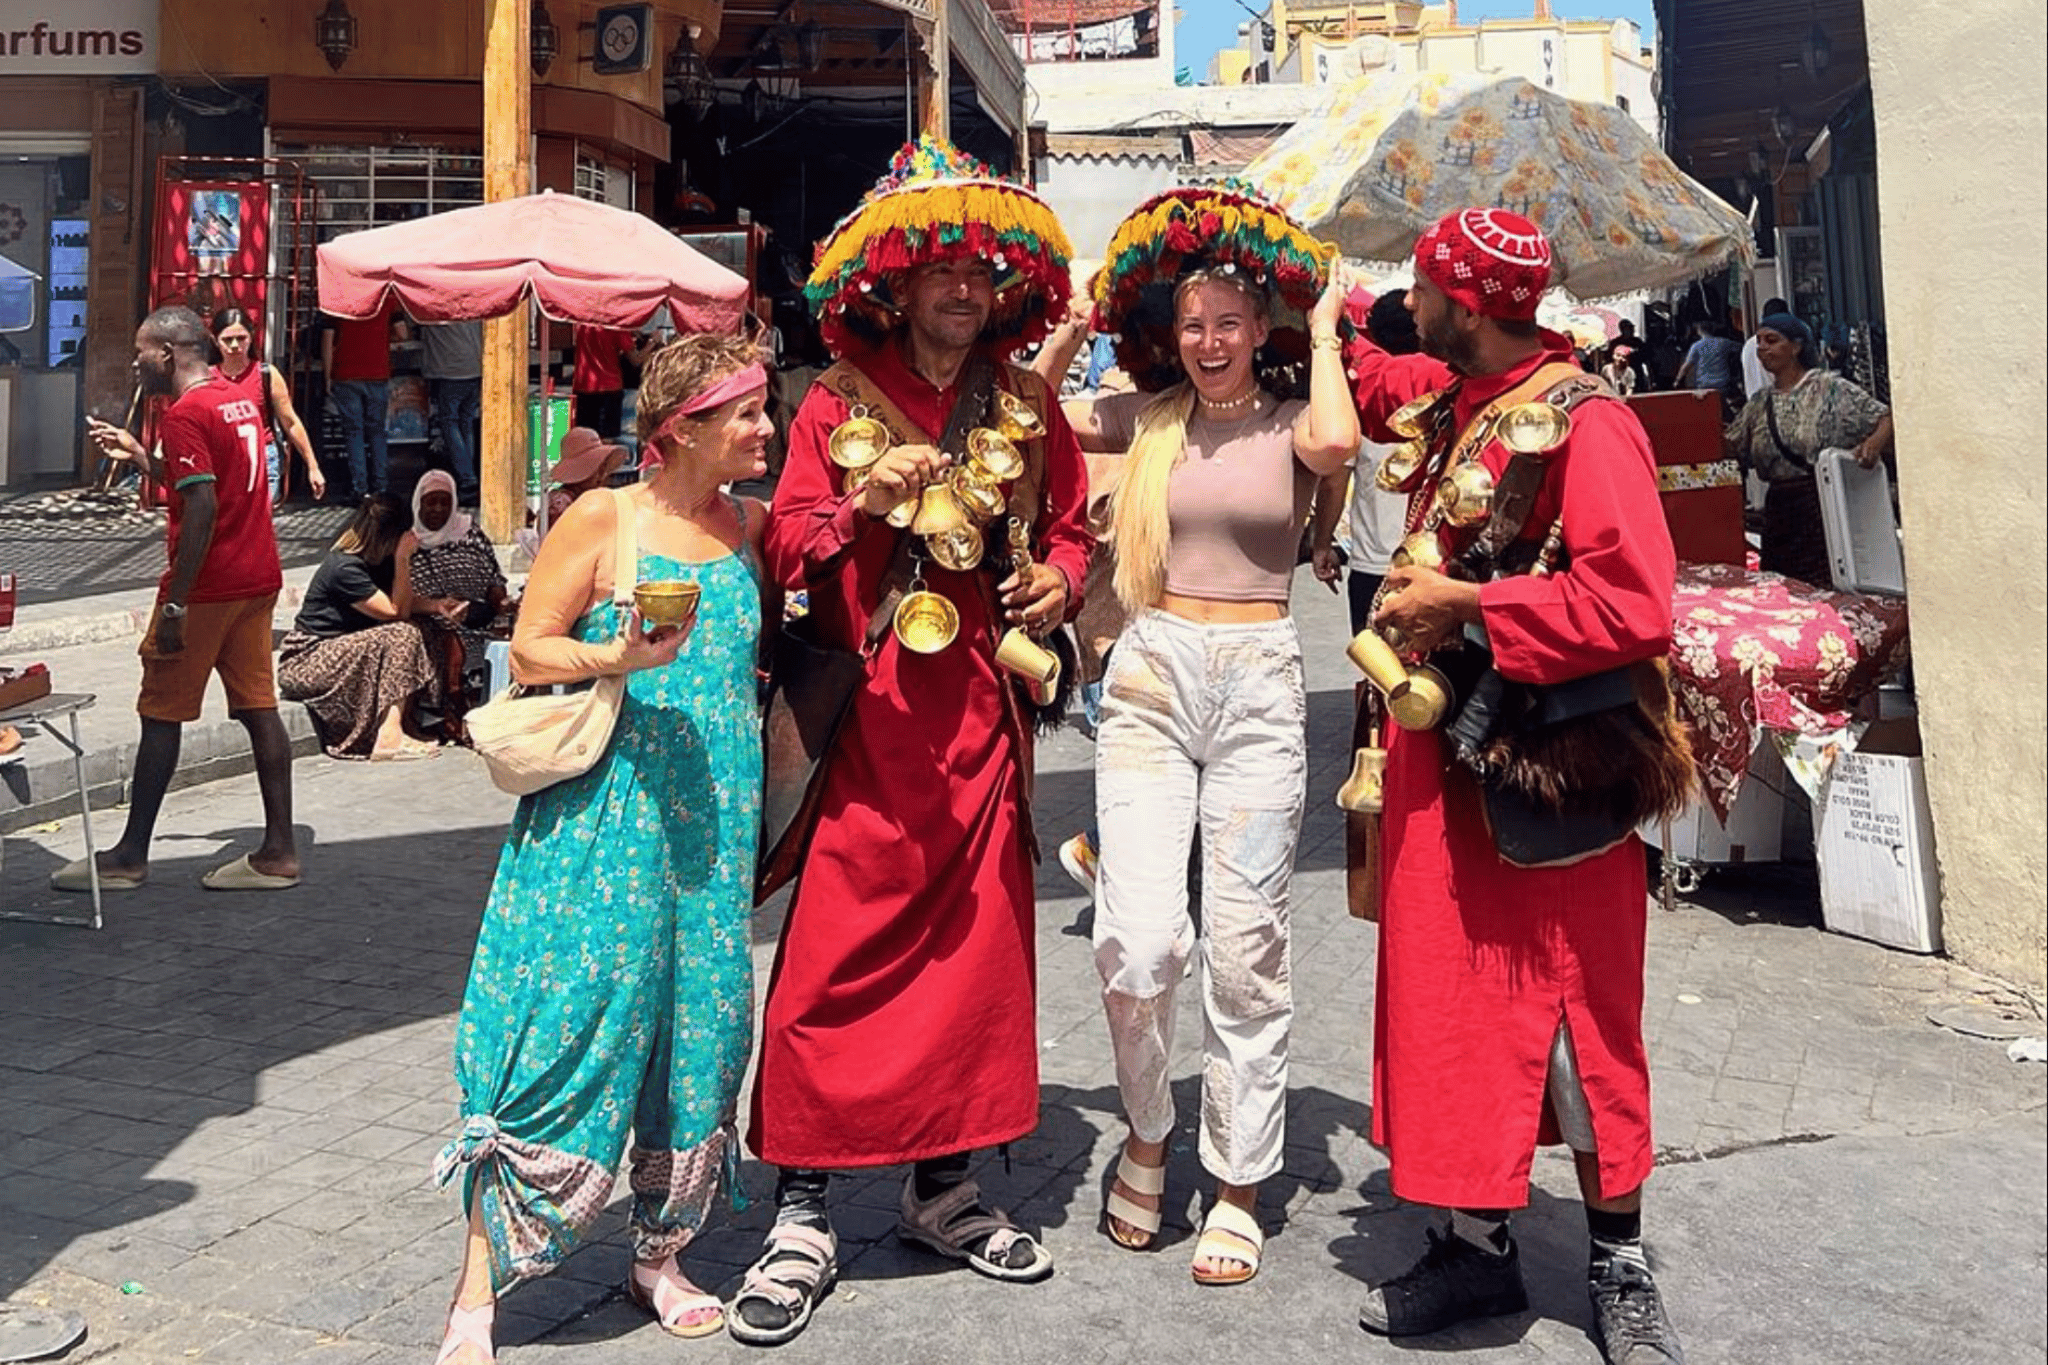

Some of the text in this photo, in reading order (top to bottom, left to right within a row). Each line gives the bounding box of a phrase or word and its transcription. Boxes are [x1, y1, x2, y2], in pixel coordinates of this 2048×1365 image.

[0, 22, 143, 55] rfums
[236, 423, 257, 492] 7
[1850, 809, 1900, 825] COLOR BLACK
